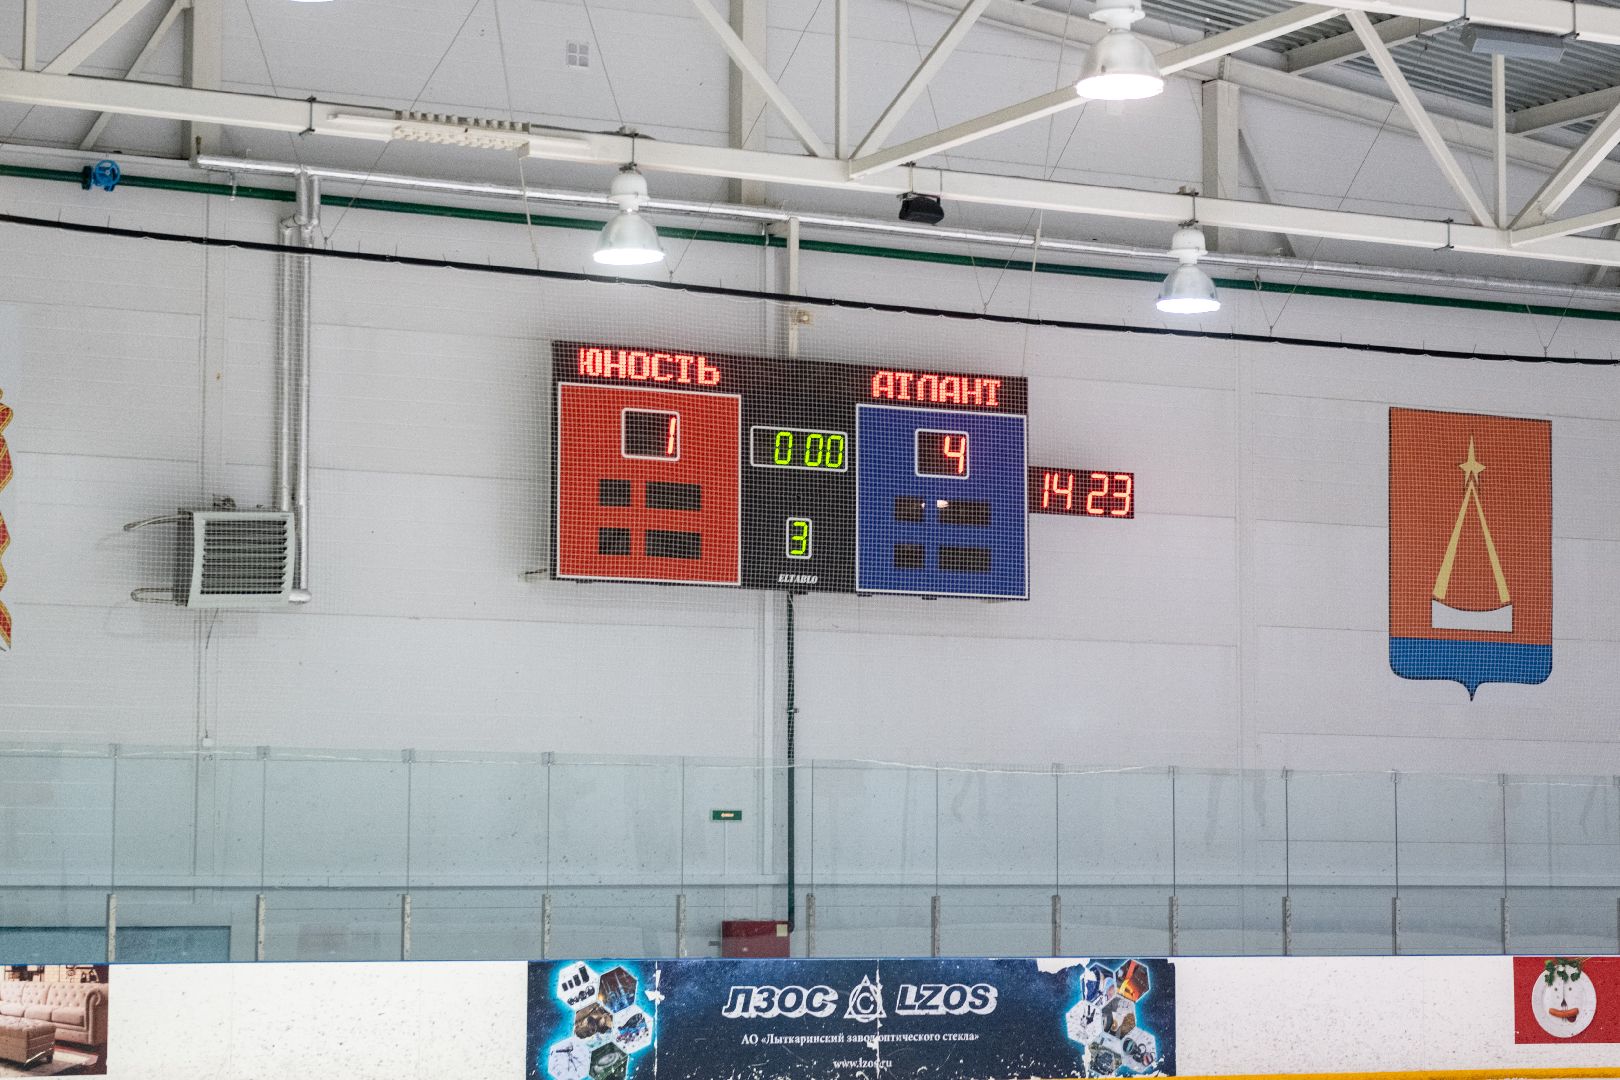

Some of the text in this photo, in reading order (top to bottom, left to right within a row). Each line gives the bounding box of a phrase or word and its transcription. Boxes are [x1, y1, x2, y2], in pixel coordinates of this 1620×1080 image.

[578, 347, 721, 385] ЮНОСТЬ
[872, 370, 1001, 406] АТЛАНТ
[667, 416, 677, 455] 1
[943, 435, 967, 474] 4
[791, 521, 808, 555] 3
[778, 573, 818, 584] ELTABLO
[722, 985, 838, 1018] ЛЗОС
[895, 983, 998, 1015] LZOS
[741, 1033, 759, 1044] АО
[761, 1033, 844, 1046] «Лыткаринский
[879, 1033, 940, 1042] оптического
[942, 1032, 979, 1041] стекла»
